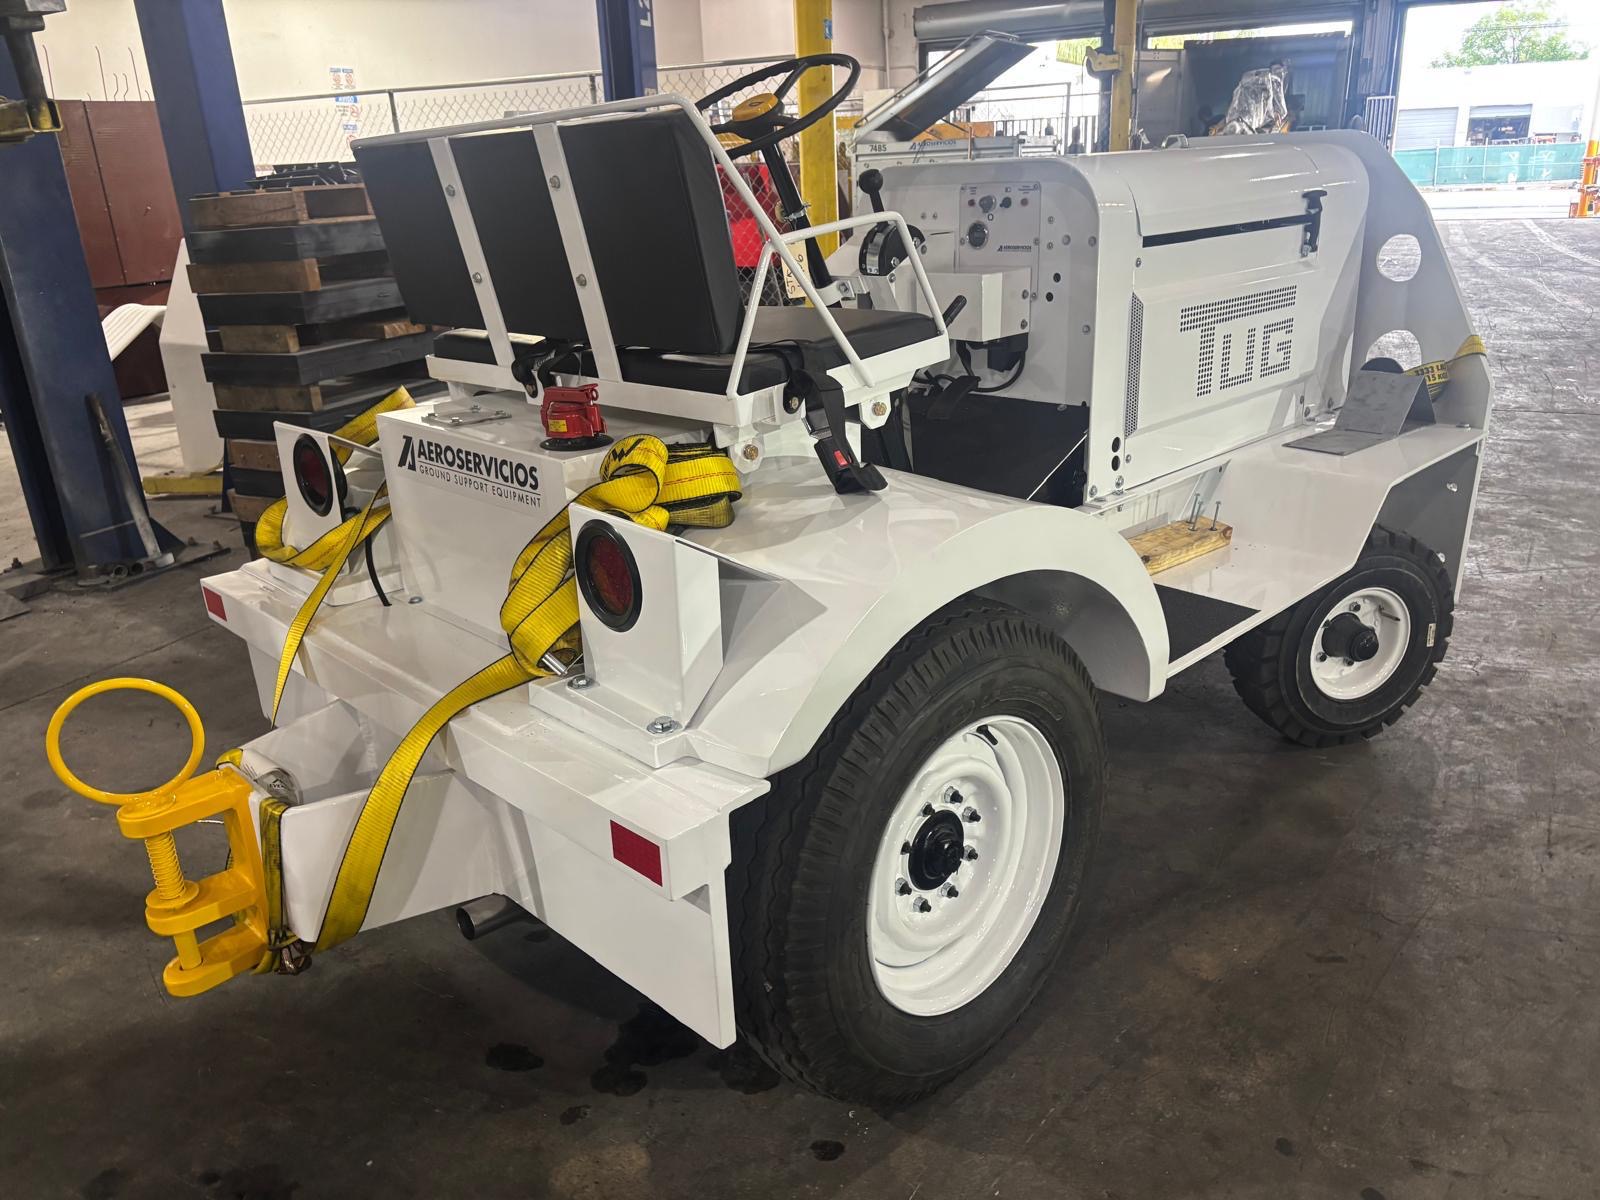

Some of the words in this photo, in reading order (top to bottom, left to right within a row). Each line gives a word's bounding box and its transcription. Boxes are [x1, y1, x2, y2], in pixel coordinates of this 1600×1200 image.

[1180, 285, 1297, 397] TUG
[417, 439, 539, 491] AEROSERVICIOS
[419, 464, 451, 482] GROUND
[454, 474, 489, 493] SUPPORT
[492, 485, 542, 508] EQUIPMENT
